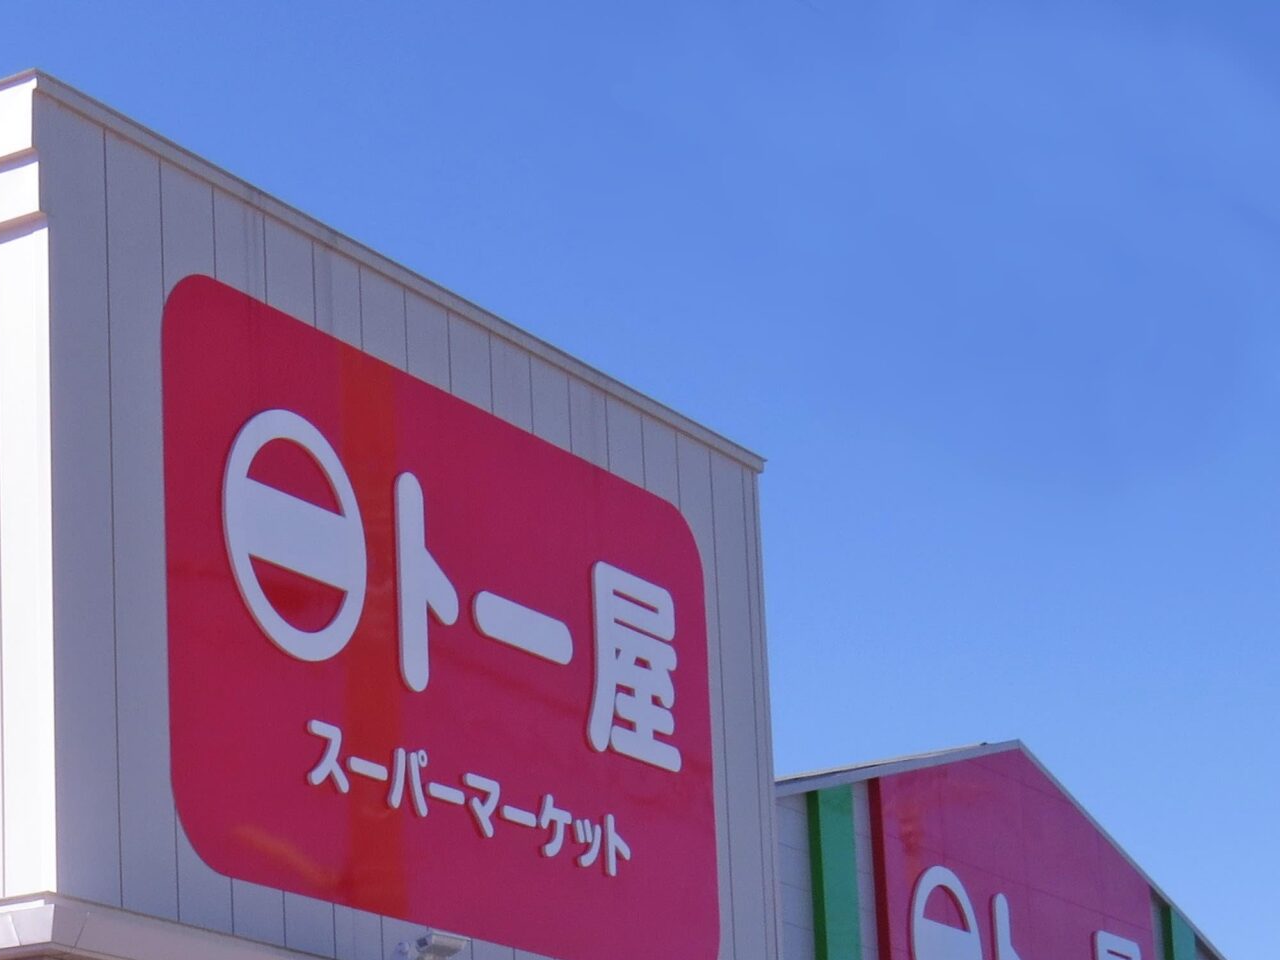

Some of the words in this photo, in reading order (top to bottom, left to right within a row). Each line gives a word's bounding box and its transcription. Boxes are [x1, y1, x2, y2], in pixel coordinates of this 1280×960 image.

[307, 719, 631, 877] スーパーマーケット
